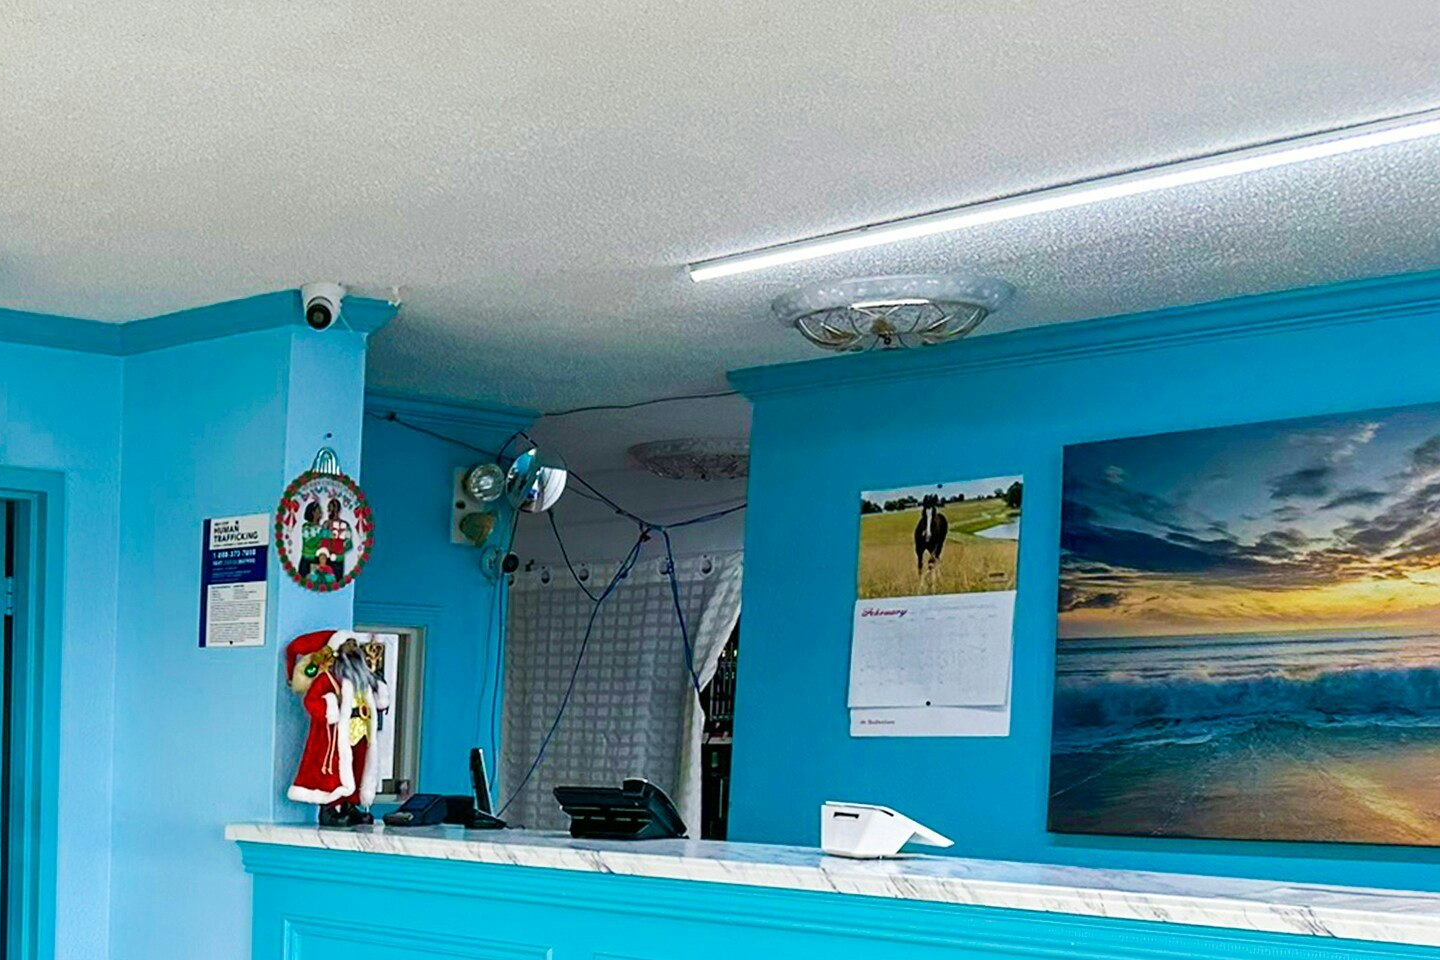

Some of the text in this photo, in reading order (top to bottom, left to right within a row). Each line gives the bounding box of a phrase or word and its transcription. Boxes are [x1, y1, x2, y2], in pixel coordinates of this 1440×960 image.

[214, 525, 239, 533] HUMAN
[214, 531, 258, 542] TRAFFICKING
[861, 607, 909, 618] February
